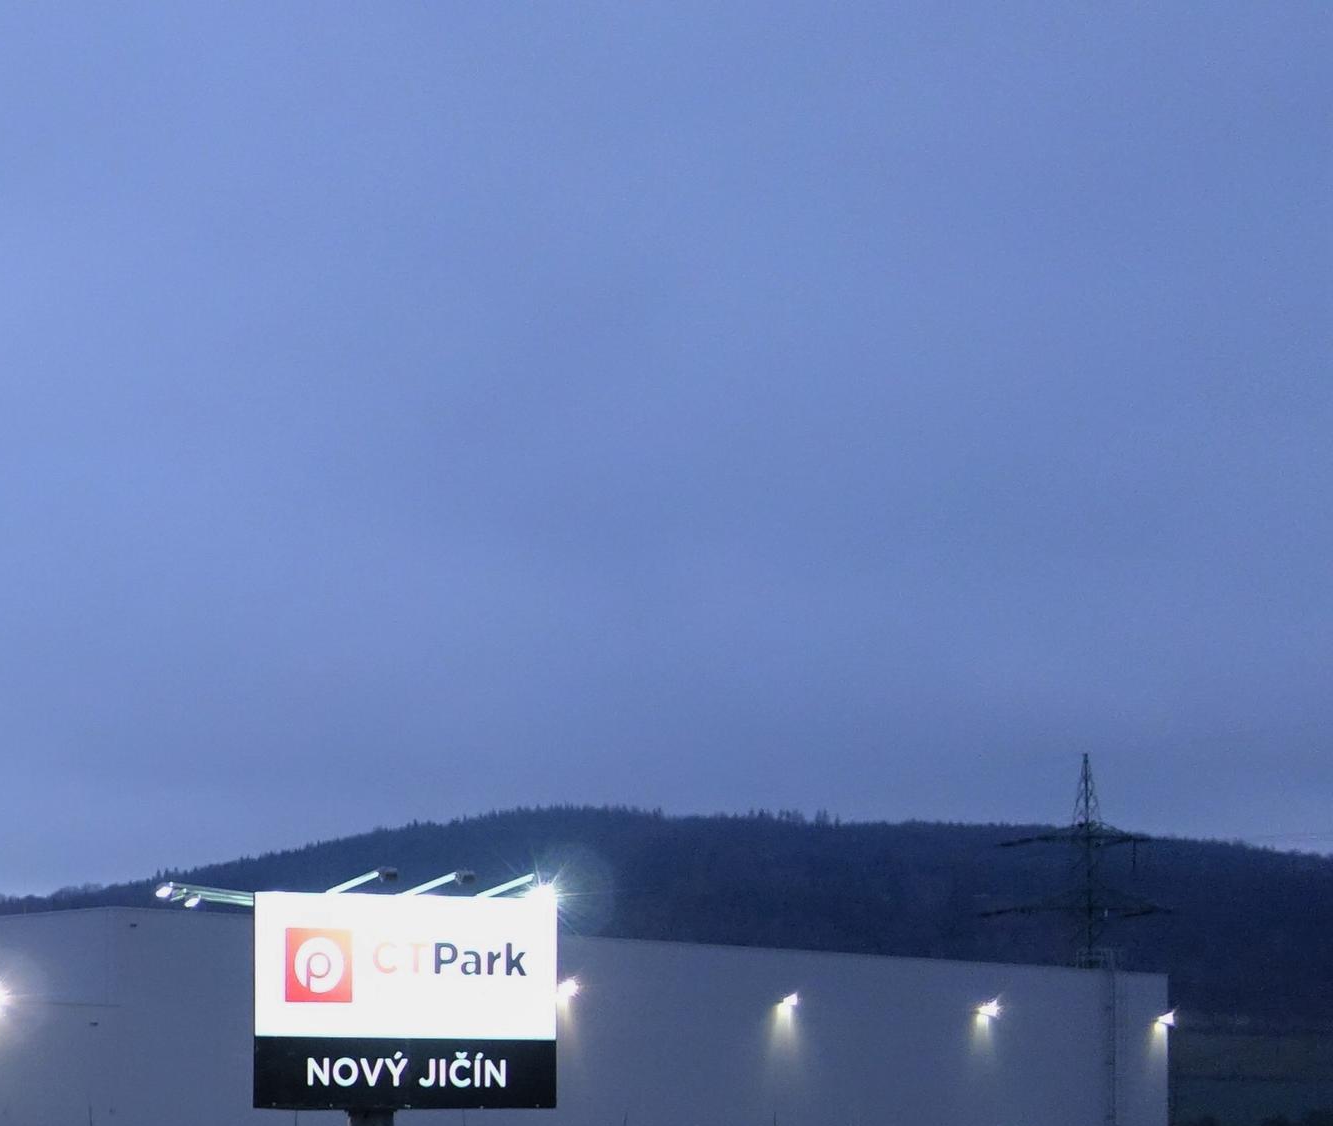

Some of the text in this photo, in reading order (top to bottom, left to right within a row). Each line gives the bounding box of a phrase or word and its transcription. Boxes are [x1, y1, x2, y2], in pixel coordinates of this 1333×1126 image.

[372, 942, 527, 976] CTPark
[307, 1051, 507, 1088] NOVÝ JIČÍN
